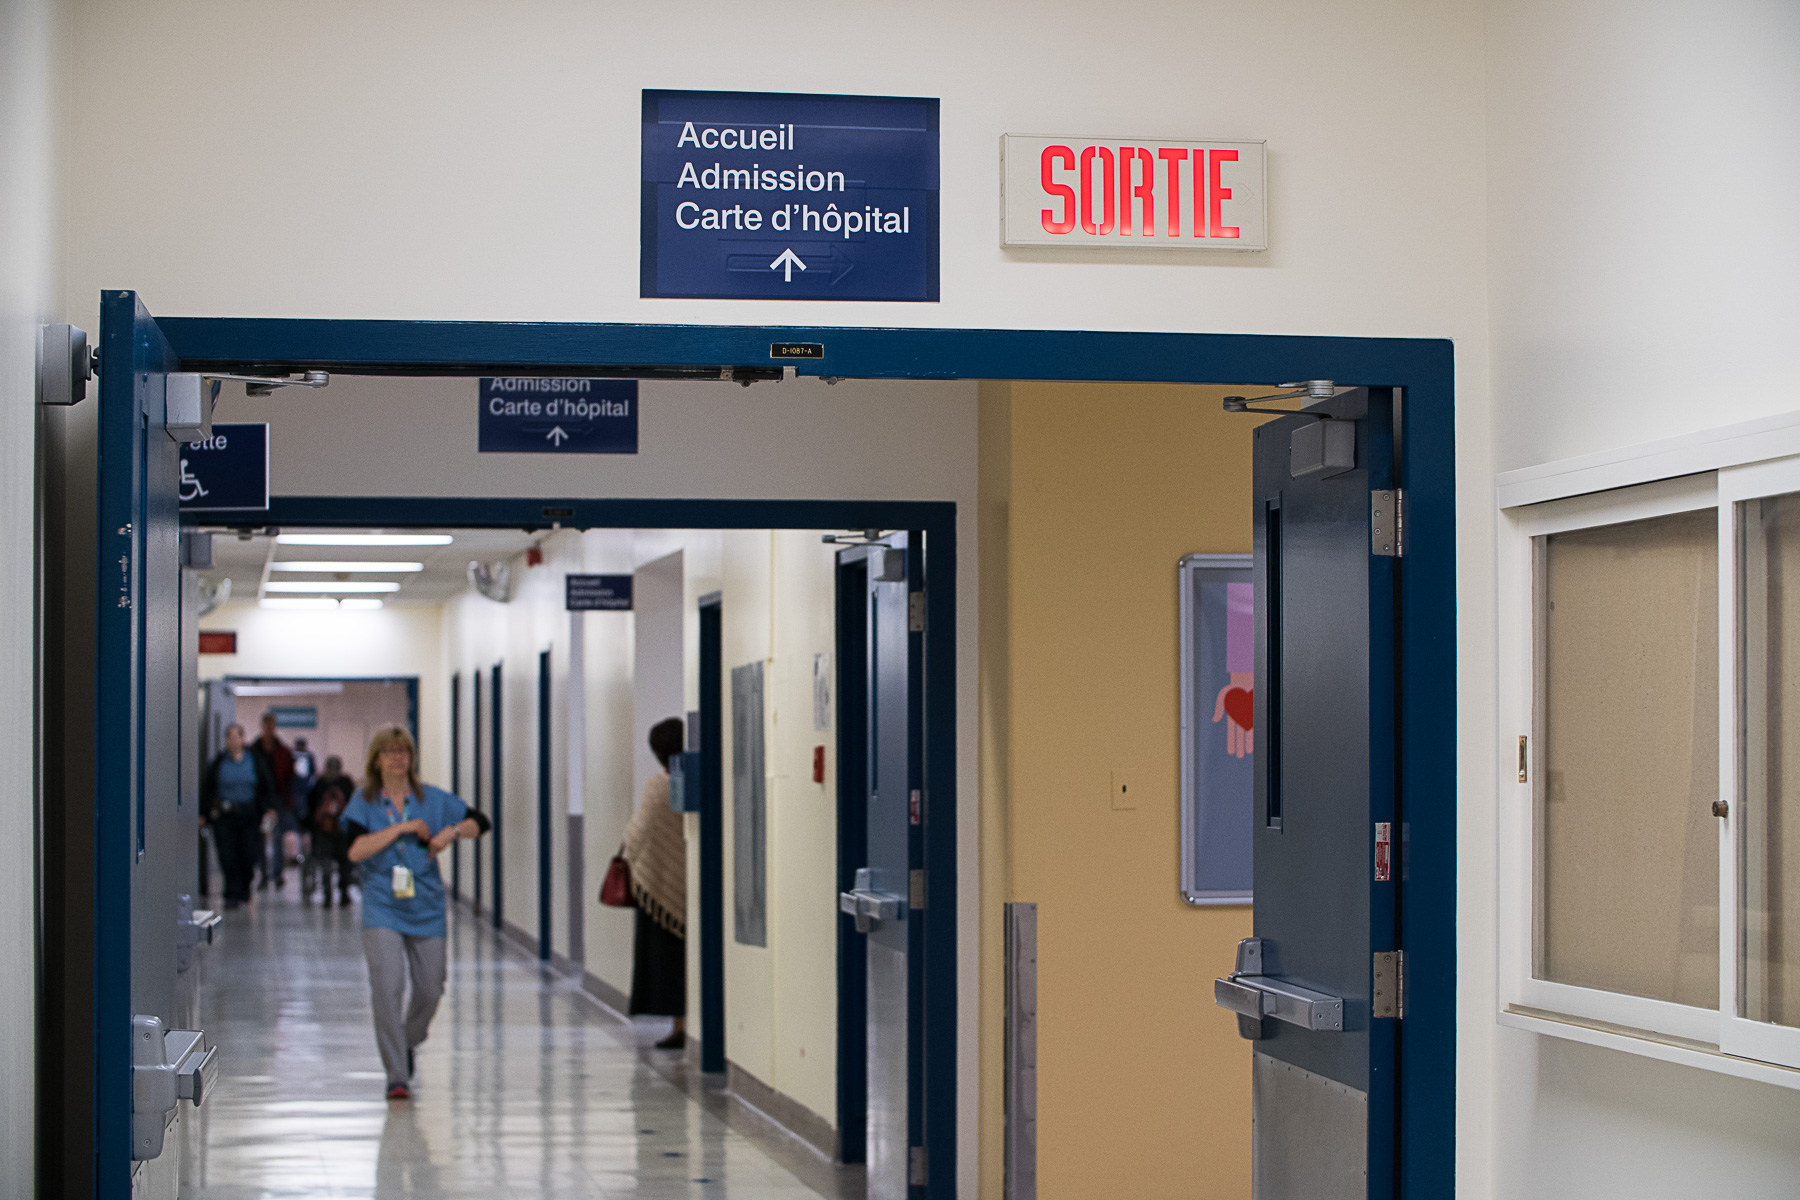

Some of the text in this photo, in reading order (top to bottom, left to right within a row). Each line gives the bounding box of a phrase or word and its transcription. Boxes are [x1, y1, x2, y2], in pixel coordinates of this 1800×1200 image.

[677, 121, 794, 150] Accueil
[677, 162, 845, 192] Admission
[1041, 145, 1240, 239] SORTIE
[675, 201, 909, 239] Carte d’hôpital
[490, 377, 591, 392] Admission
[490, 397, 541, 416] Carte
